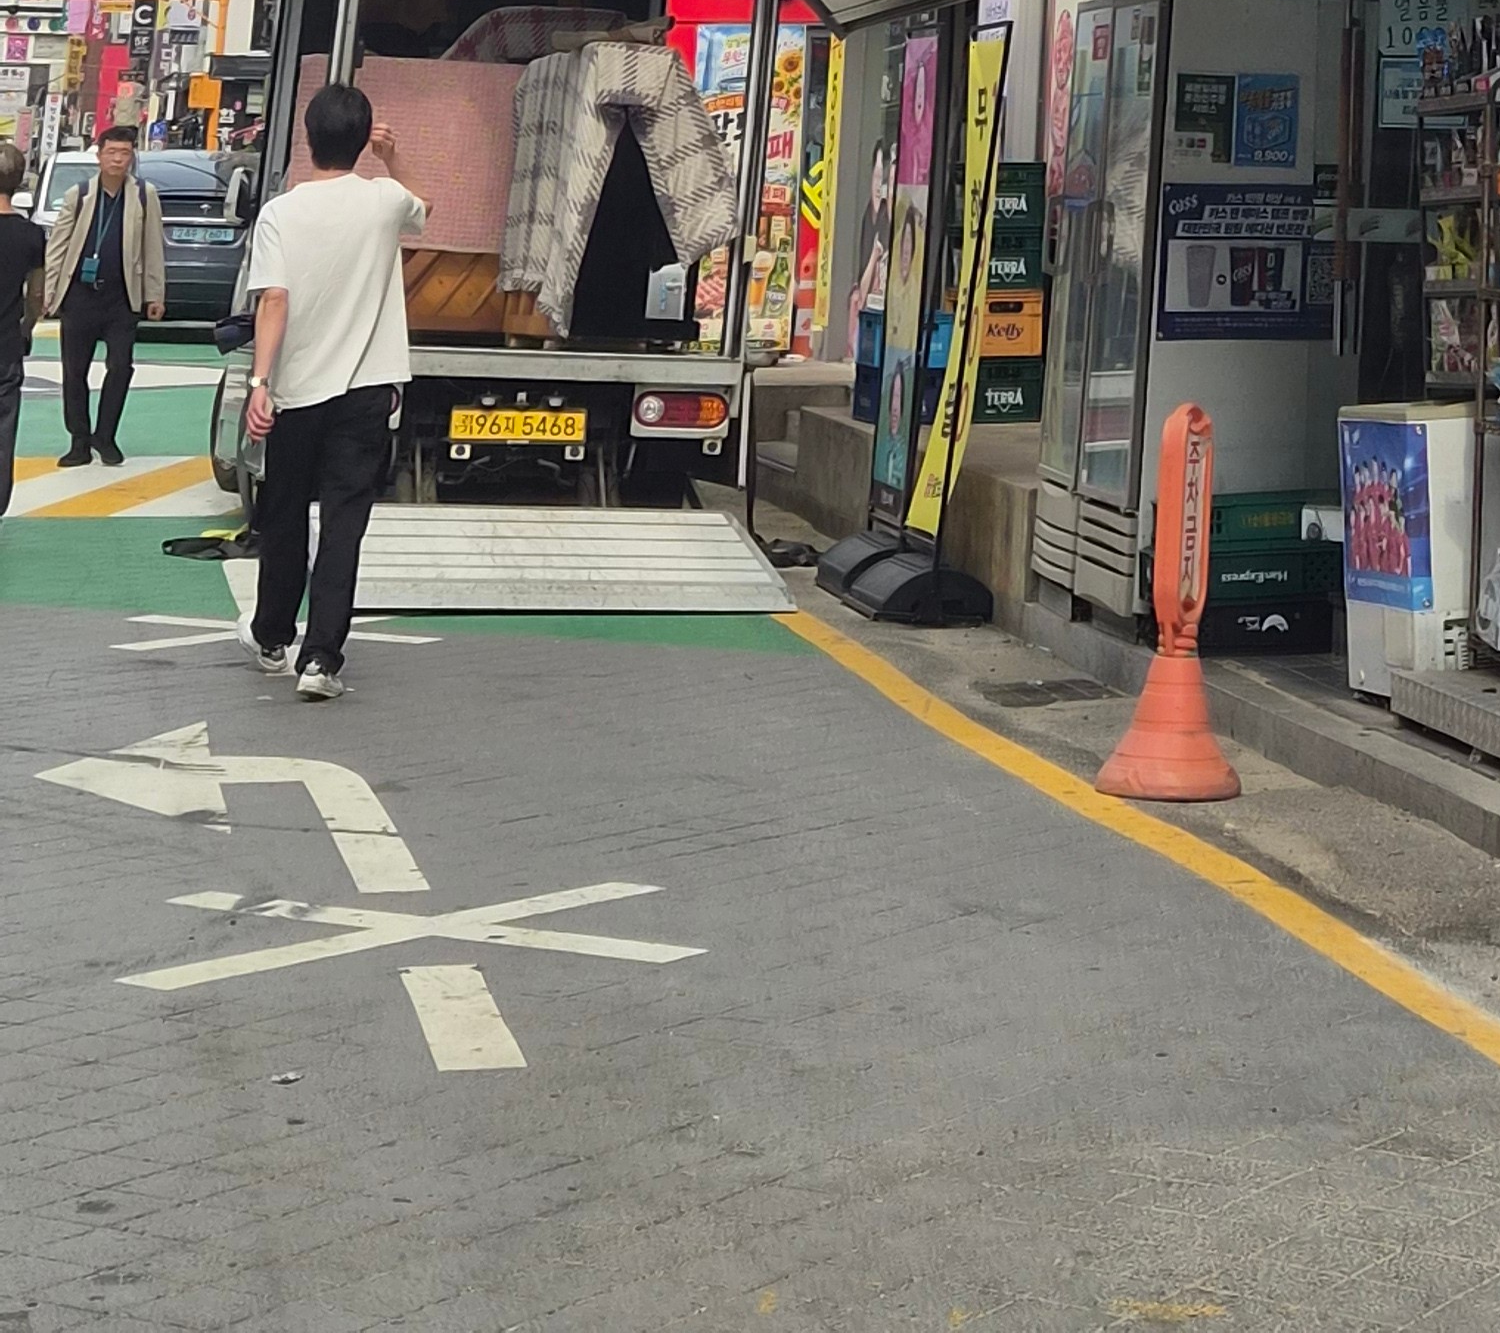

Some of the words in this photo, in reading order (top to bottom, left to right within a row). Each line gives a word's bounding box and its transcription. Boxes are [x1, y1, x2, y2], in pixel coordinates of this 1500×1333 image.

[1168, 194, 1199, 216] Cass
[989, 256, 1028, 276] TERRA
[985, 319, 1025, 343] Kelly
[984, 385, 1025, 406] TERRA
[521, 415, 577, 437] 5468
[1181, 439, 1202, 583] 주차금지
